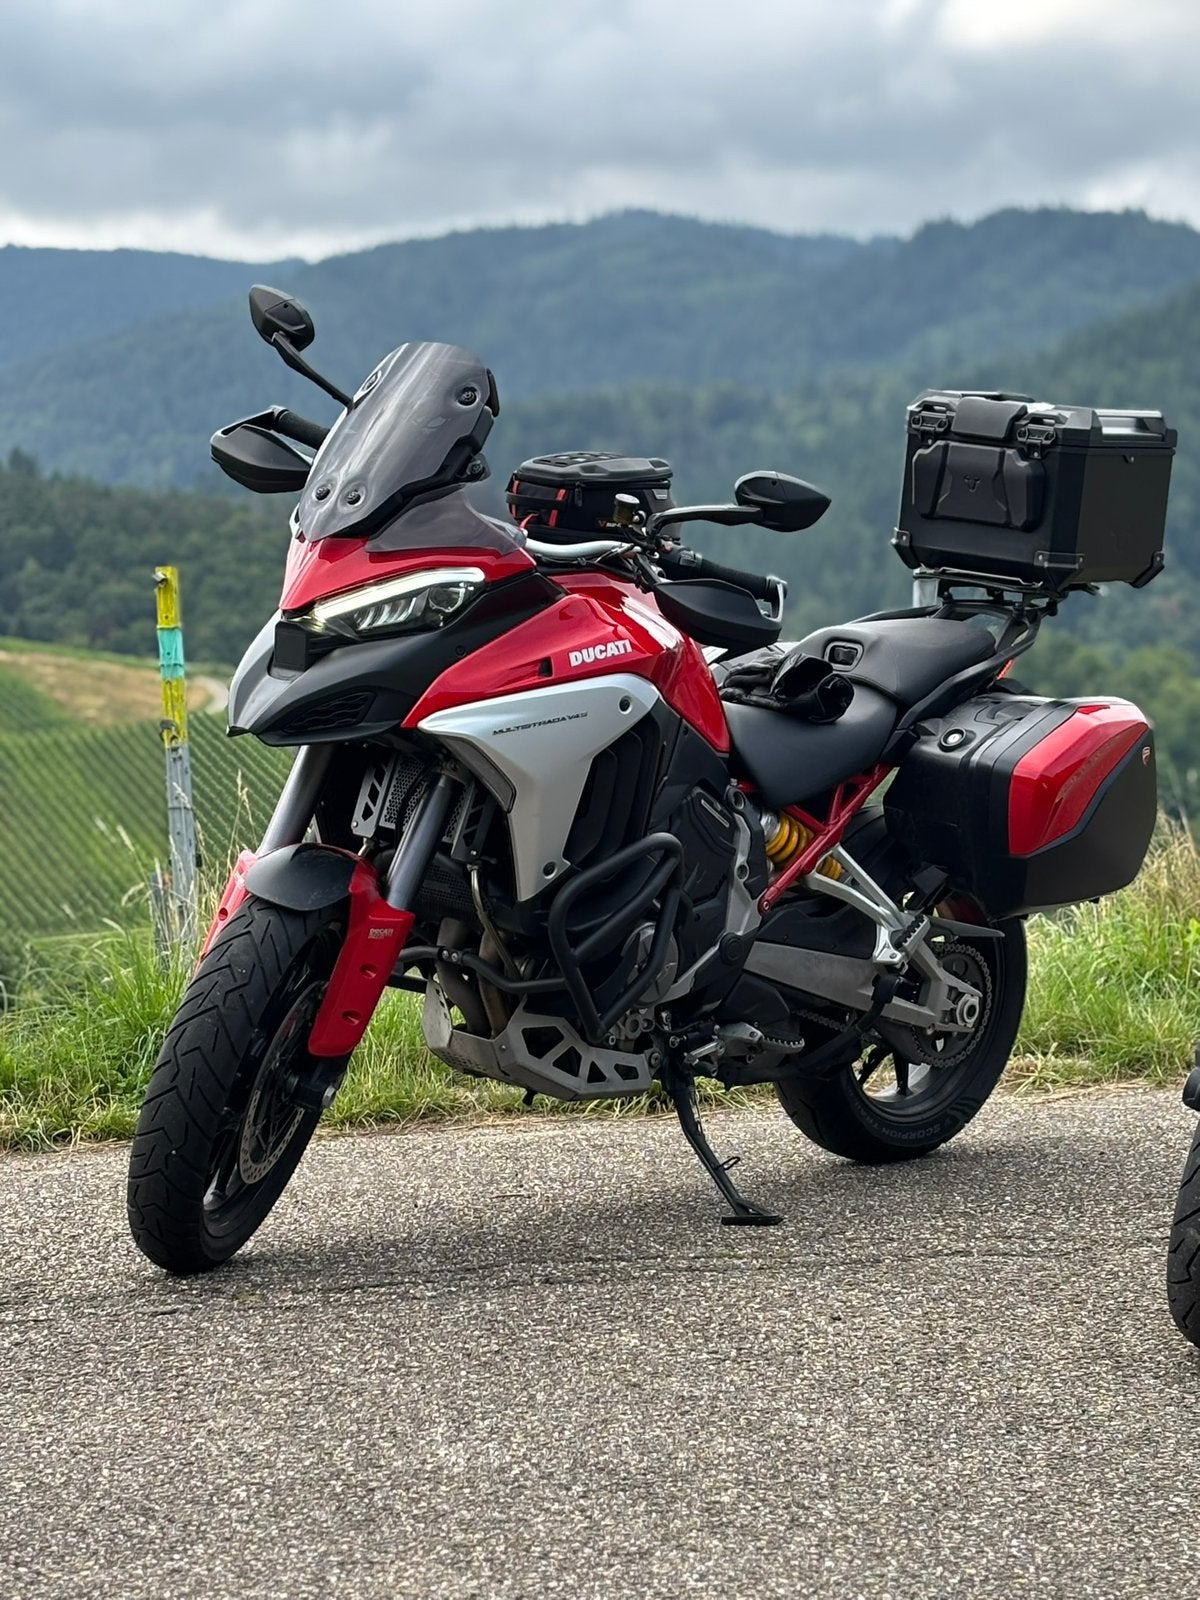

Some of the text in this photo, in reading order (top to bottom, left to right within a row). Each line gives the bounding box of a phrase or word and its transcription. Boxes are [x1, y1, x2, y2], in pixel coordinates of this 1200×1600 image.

[569, 639, 632, 666] DUCATI
[493, 716, 567, 735] MULTISTRADA
[882, 1123, 941, 1139] SCORPION
